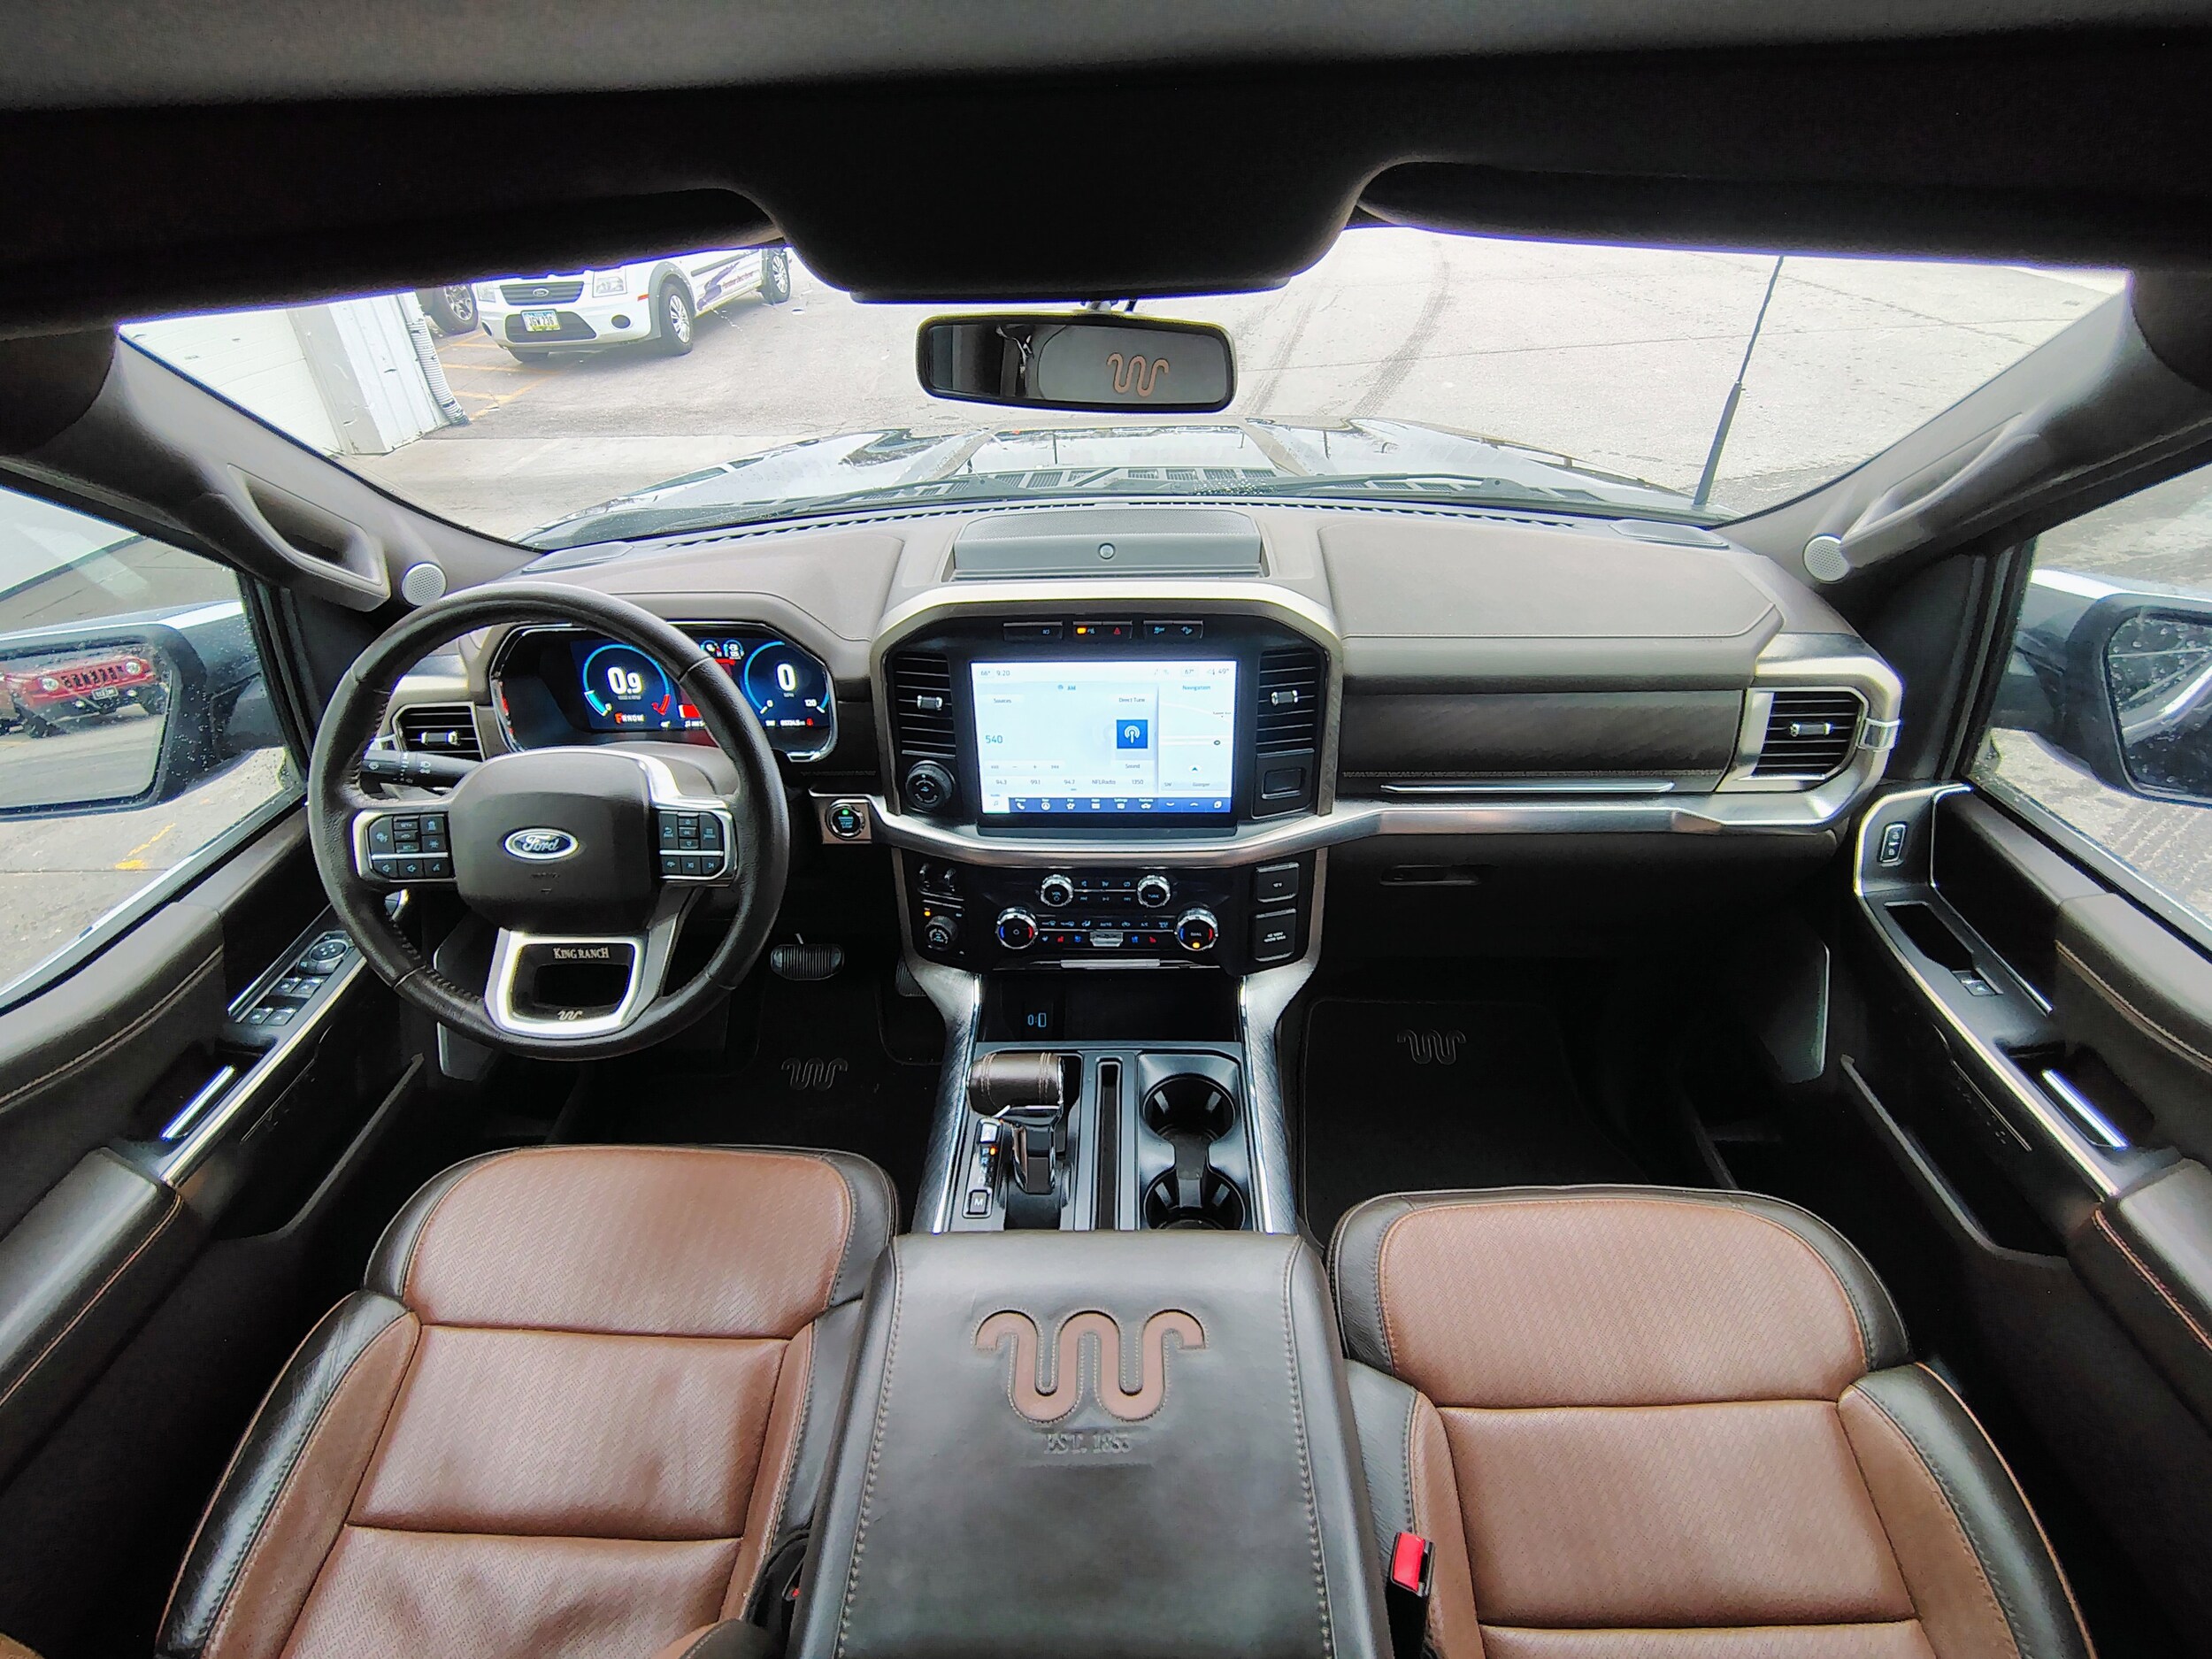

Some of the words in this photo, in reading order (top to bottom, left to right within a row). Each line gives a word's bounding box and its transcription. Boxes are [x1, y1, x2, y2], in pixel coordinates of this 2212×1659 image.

[777, 664, 796, 691] 0
[985, 734, 1003, 744] 540
[522, 834, 559, 851] Ford
[553, 948, 577, 959] KING
[577, 947, 610, 958] RANCH
